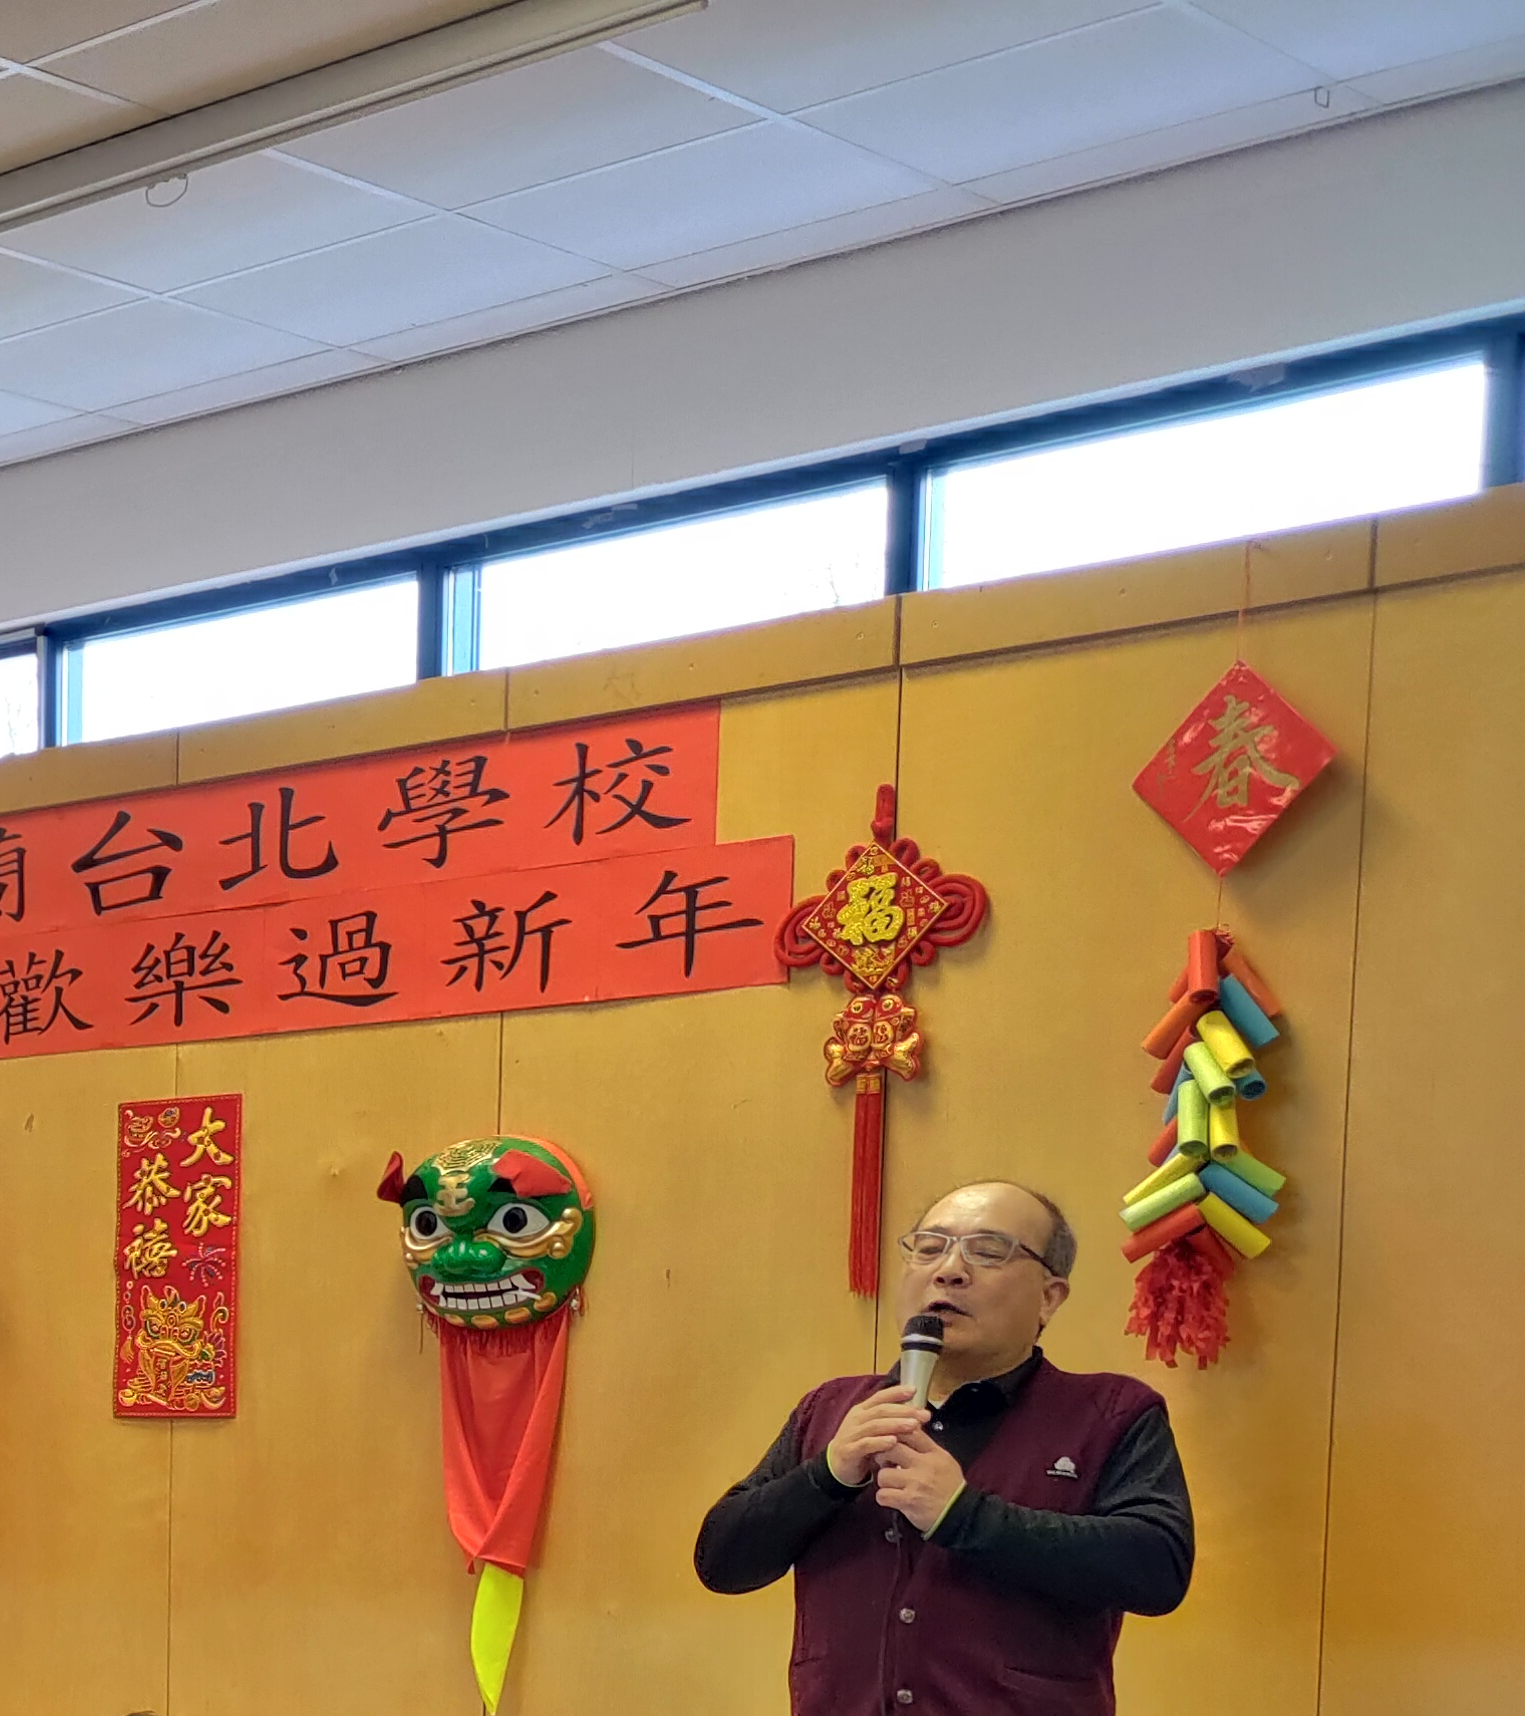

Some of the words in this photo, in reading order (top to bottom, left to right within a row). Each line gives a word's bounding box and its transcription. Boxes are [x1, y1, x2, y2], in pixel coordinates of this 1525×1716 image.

[1180, 694, 1300, 824] 春
[836, 872, 905, 947] 福
[123, 1152, 181, 1280] 恭禧
[180, 1105, 235, 1237] 大家
